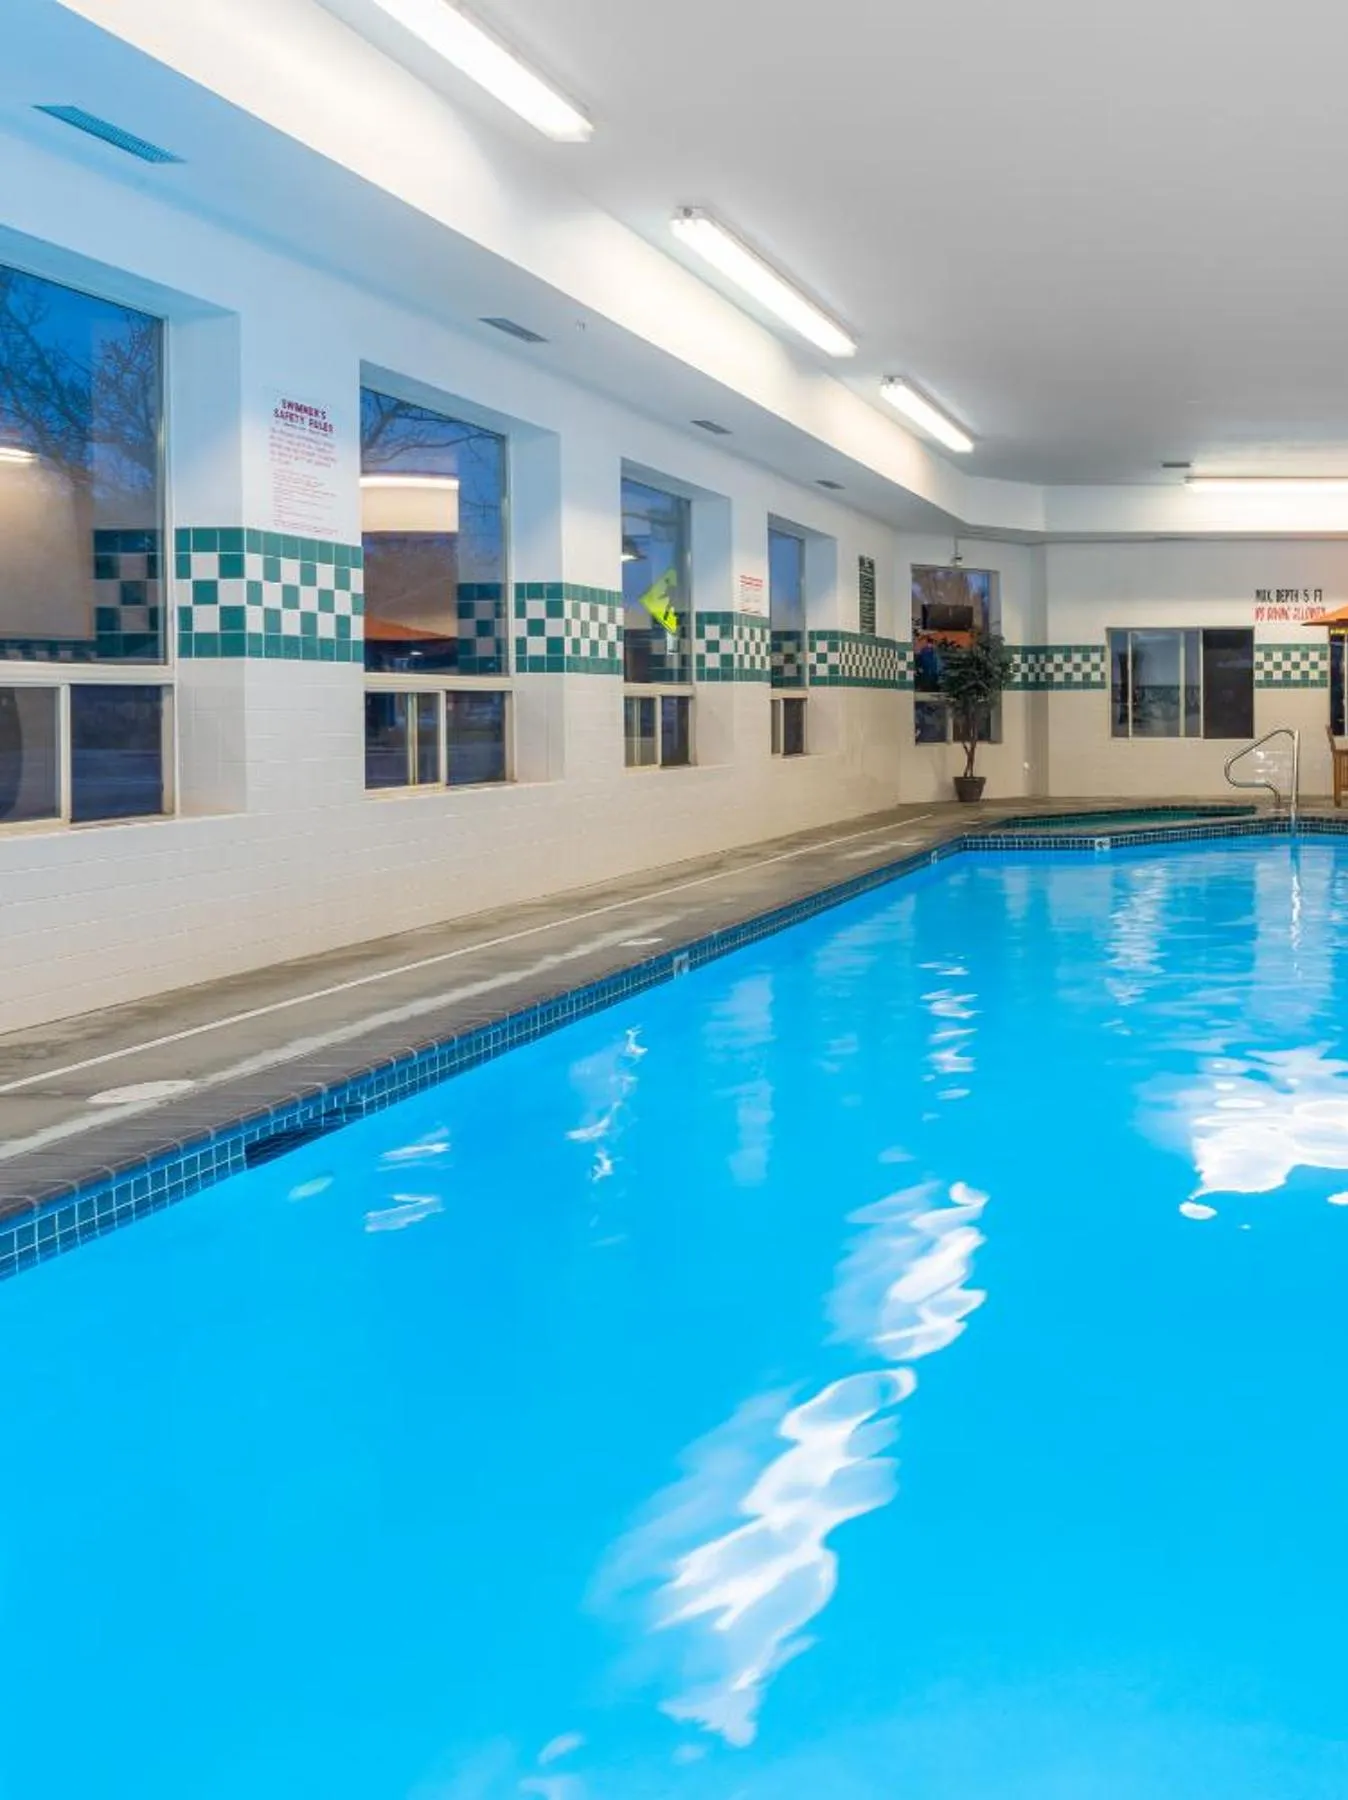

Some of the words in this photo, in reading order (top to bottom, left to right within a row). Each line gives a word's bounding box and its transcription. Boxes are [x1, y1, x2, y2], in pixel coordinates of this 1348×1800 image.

[273, 407, 305, 424] SAFETY
[309, 418, 334, 433] RULES
[1276, 589, 1299, 602] DEPTH
